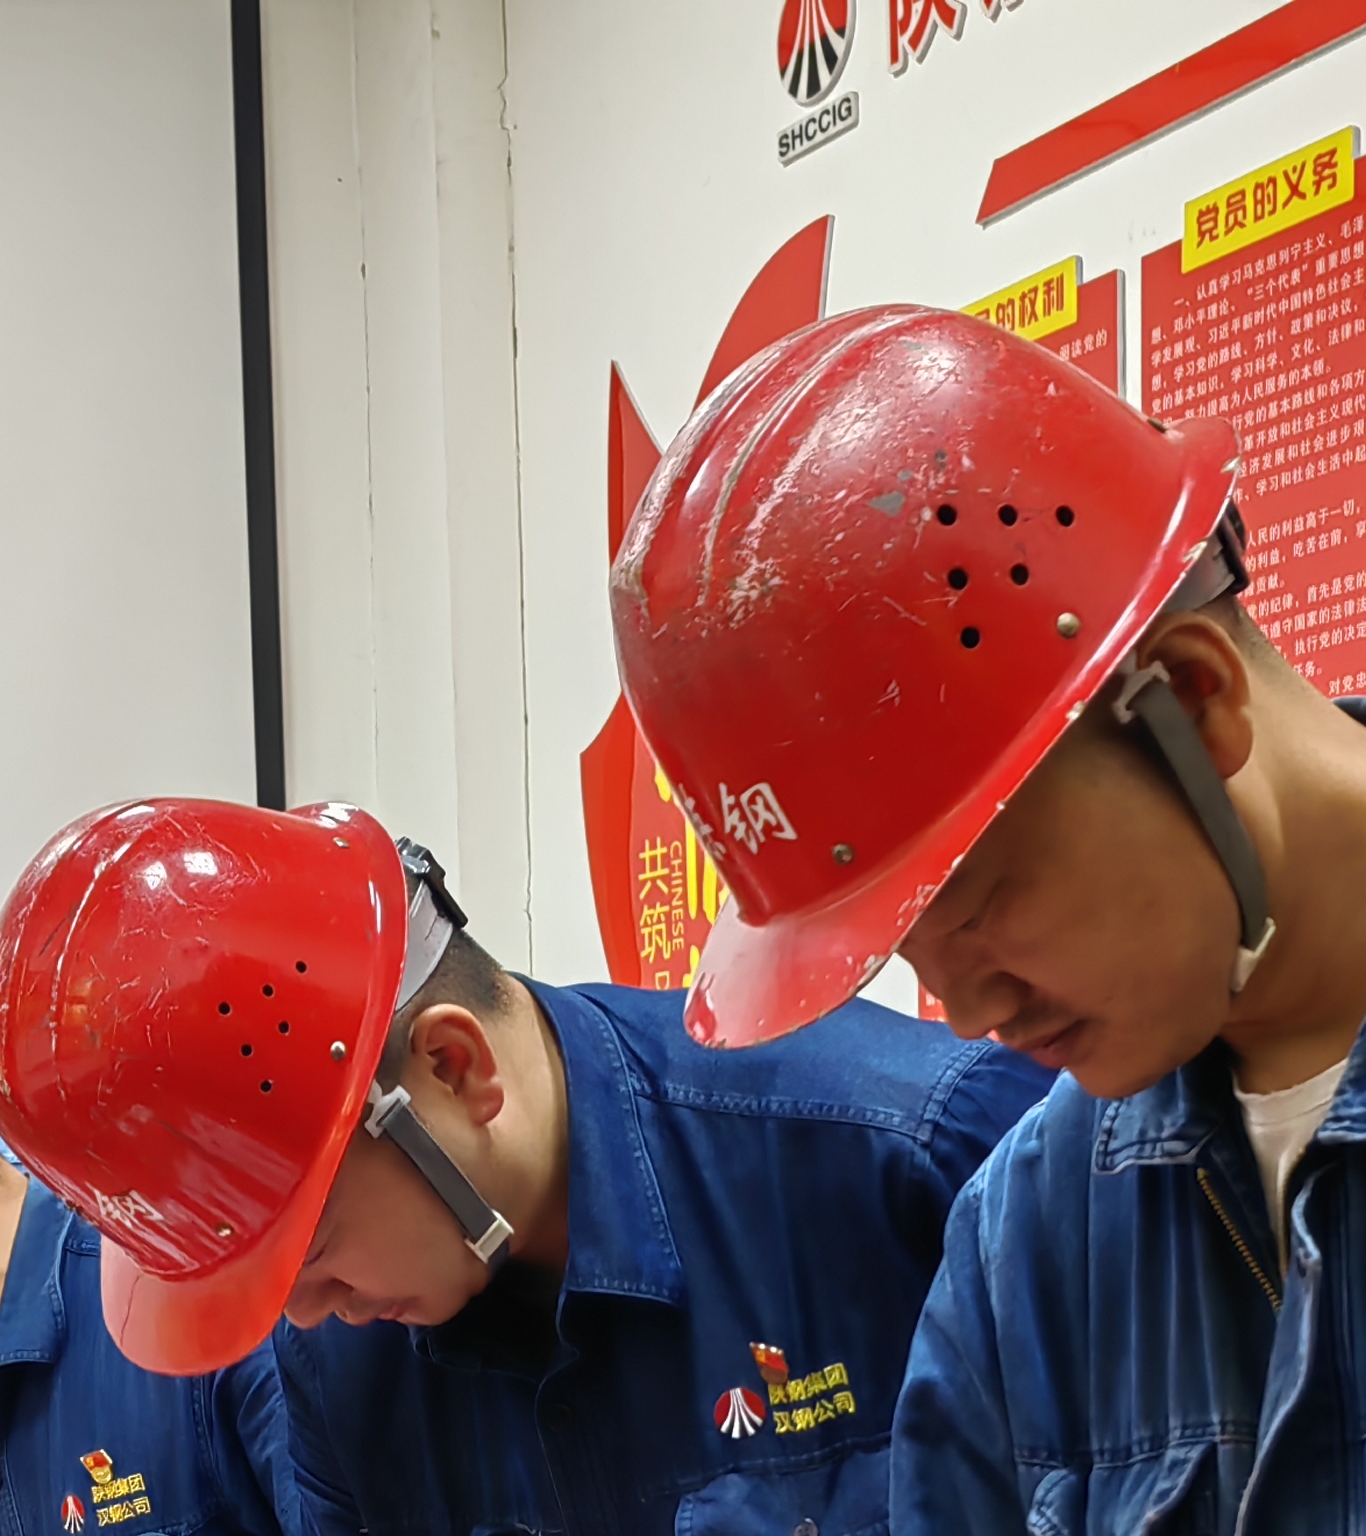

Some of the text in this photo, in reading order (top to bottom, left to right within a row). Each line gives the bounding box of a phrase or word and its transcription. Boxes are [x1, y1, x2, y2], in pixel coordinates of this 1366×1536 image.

[778, 97, 853, 159] SHCCIG
[1196, 145, 1340, 249] 党员的义务
[638, 836, 671, 963] 共筑
[669, 841, 685, 951] CHINESE
[773, 1390, 857, 1435] 汉钢公司
[96, 1496, 152, 1527] 汉钢公司
